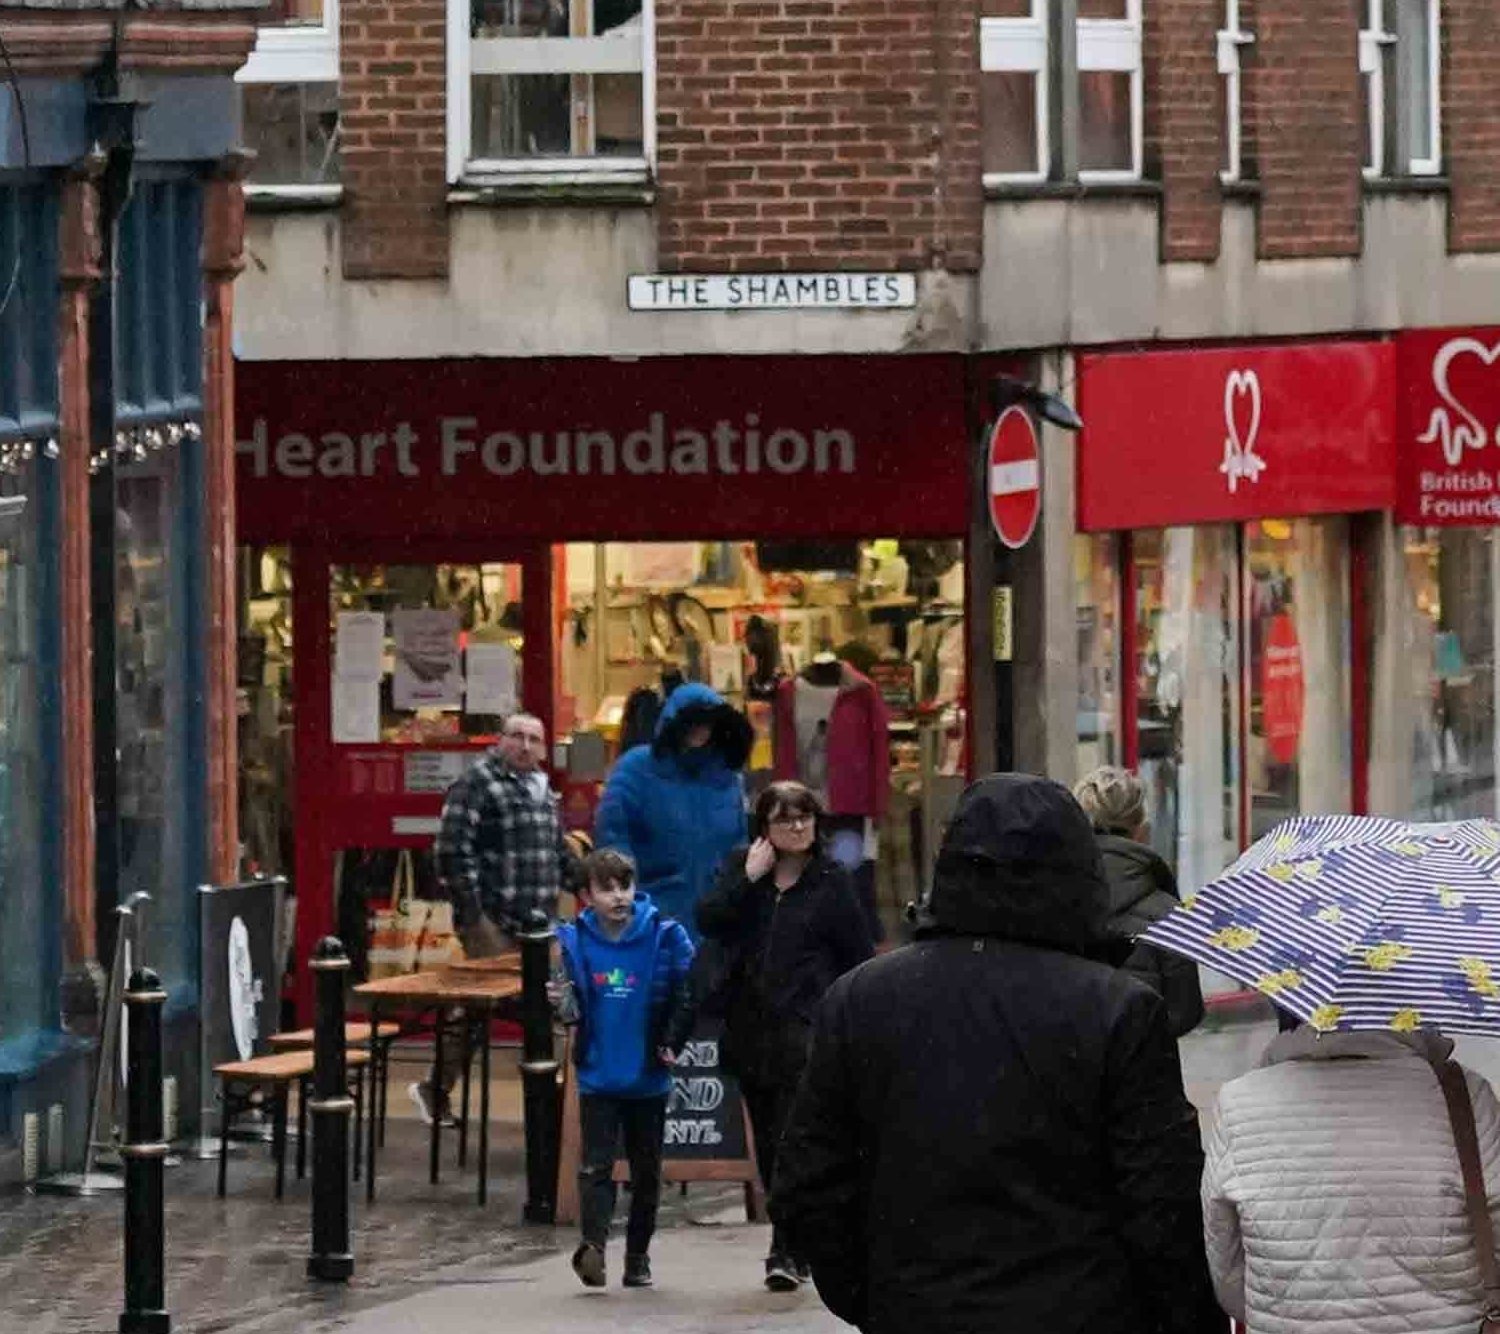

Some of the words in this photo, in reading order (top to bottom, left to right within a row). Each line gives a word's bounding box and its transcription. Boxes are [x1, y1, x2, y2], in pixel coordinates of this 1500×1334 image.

[646, 278, 710, 305] THE
[727, 276, 902, 304] SHAMBLES
[235, 417, 420, 478] Heart
[440, 413, 857, 478] Foundation
[1420, 471, 1493, 491] British
